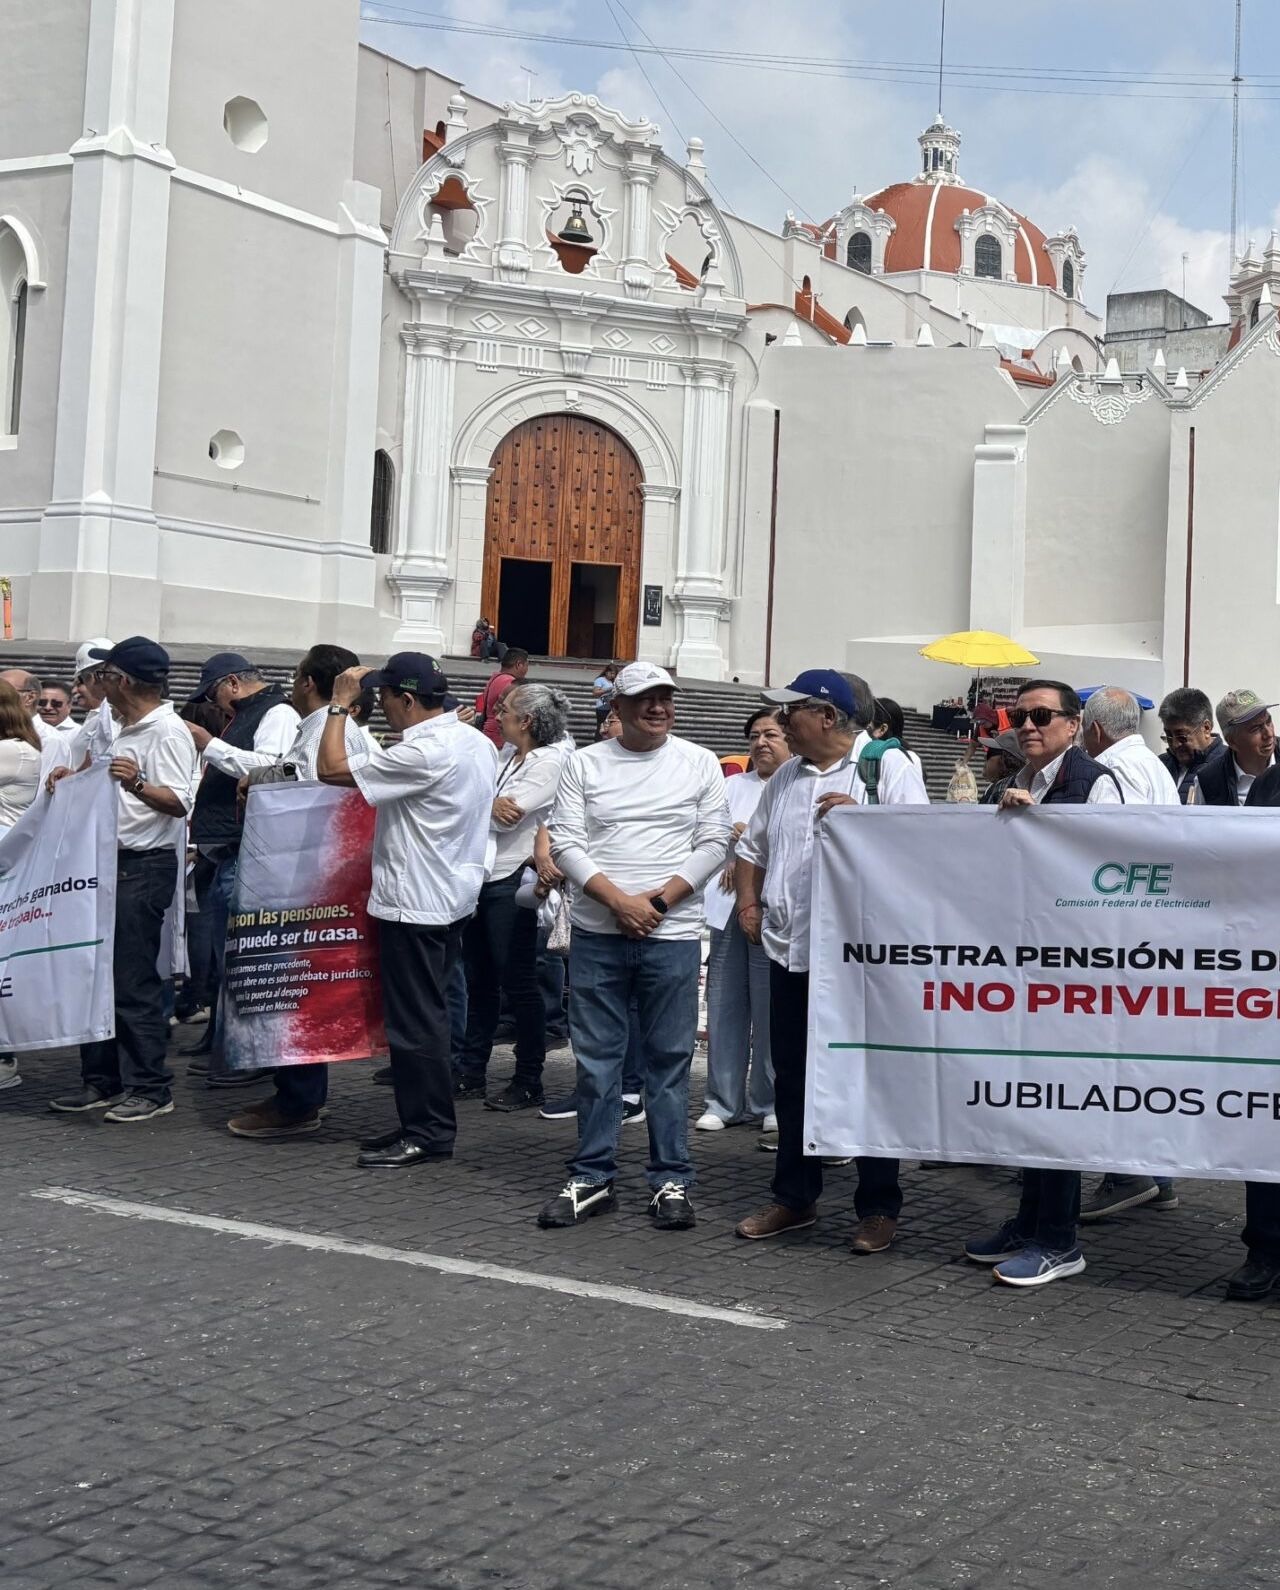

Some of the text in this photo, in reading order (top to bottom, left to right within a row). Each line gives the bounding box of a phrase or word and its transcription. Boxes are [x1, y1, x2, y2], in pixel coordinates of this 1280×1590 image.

[30, 876, 99, 904] ganados
[1091, 861, 1174, 896] CFE
[258, 907, 279, 926] las
[280, 902, 355, 927] pensiones.
[1055, 897, 1211, 909] Comisión Federal de Electricidad
[238, 930, 278, 954] puede
[280, 932, 301, 946] ser
[303, 928, 317, 943] tu
[319, 926, 364, 942] casa.
[257, 962, 272, 972] este
[272, 958, 311, 973] precedente,
[842, 942, 1008, 967] NUESTRA
[1015, 941, 1184, 970] PENSIÓN
[1193, 948, 1243, 971] ES
[258, 977, 267, 986] no
[268, 977, 275, 985] es
[276, 972, 289, 984] solo
[289, 974, 299, 983] un
[299, 970, 329, 981] debate
[330, 968, 373, 982] jurídico,
[251, 989, 273, 1003] puerta
[273, 987, 281, 998] al
[281, 985, 308, 999] despojo
[266, 1004, 273, 1012] en
[274, 1000, 300, 1011] México.
[923, 980, 1015, 1012] ¡NO
[966, 1080, 1206, 1117] JUBILADOS
